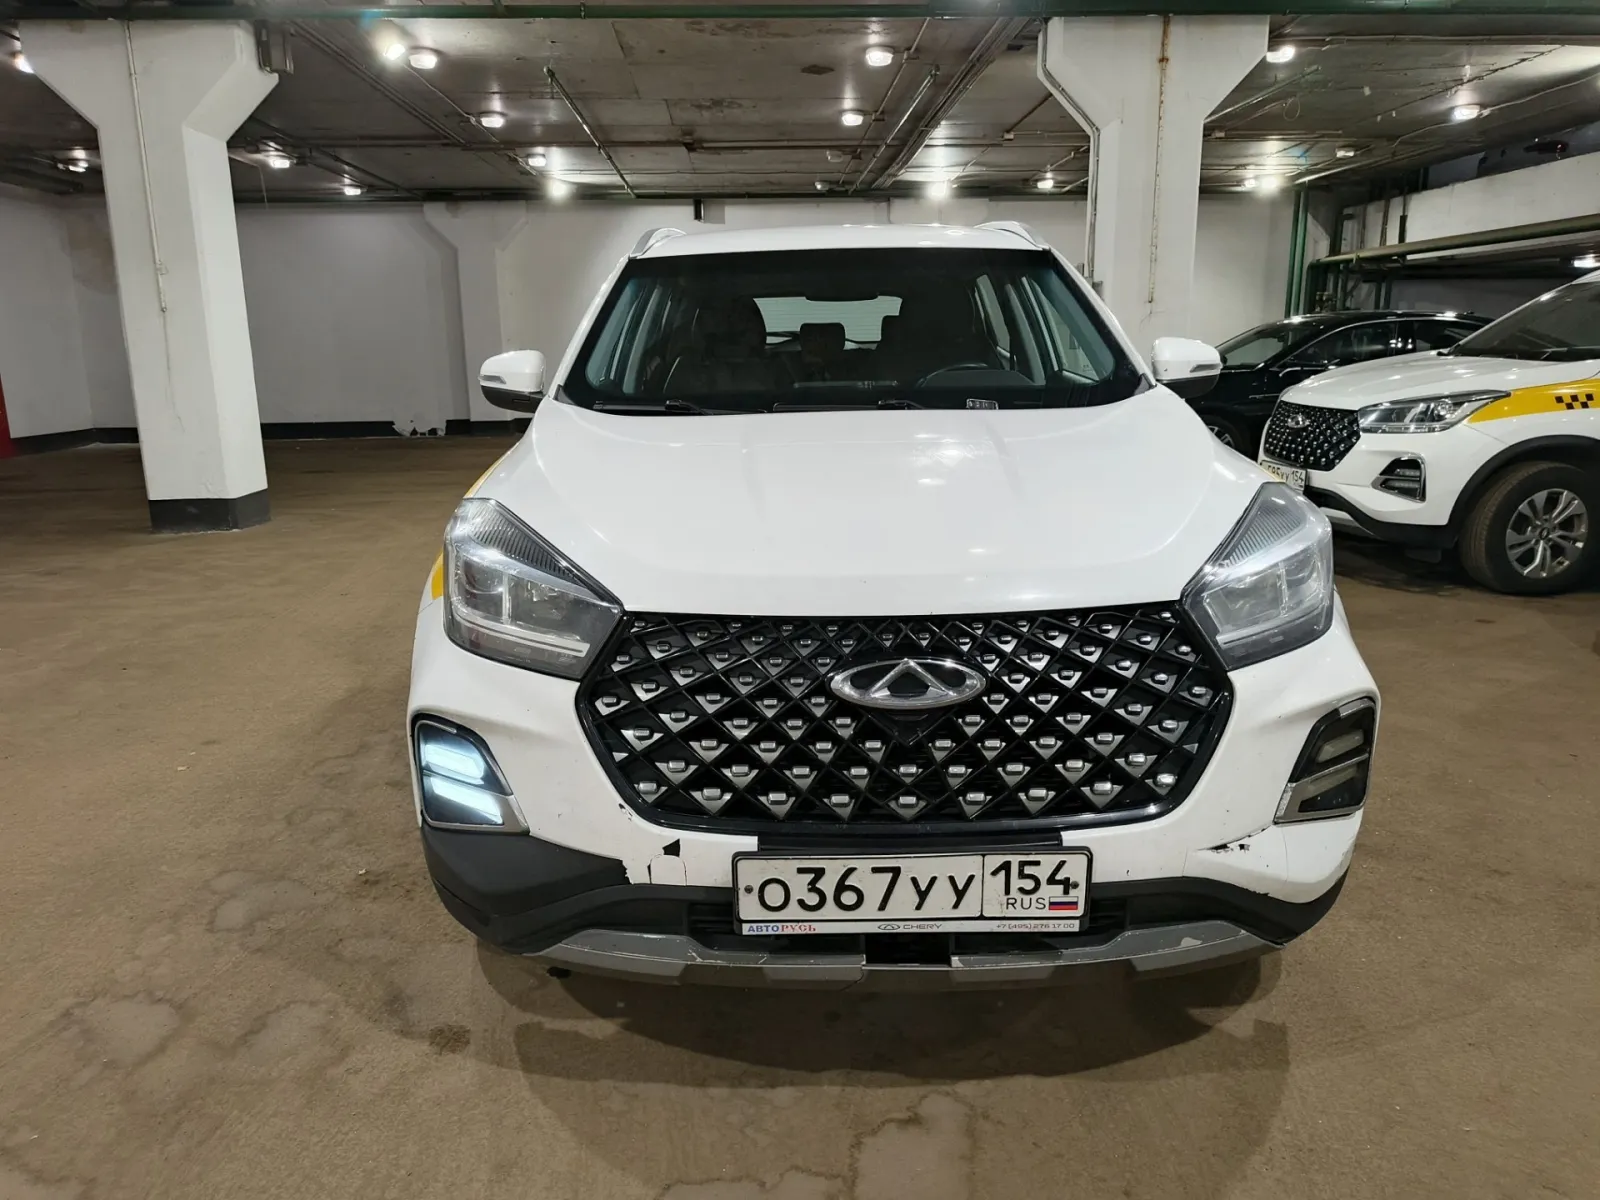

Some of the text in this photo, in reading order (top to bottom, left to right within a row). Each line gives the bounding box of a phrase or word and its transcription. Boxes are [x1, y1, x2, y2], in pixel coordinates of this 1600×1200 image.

[1291, 470, 1304, 483] 154
[990, 860, 1071, 896] 154
[1006, 897, 1046, 910] RUS
